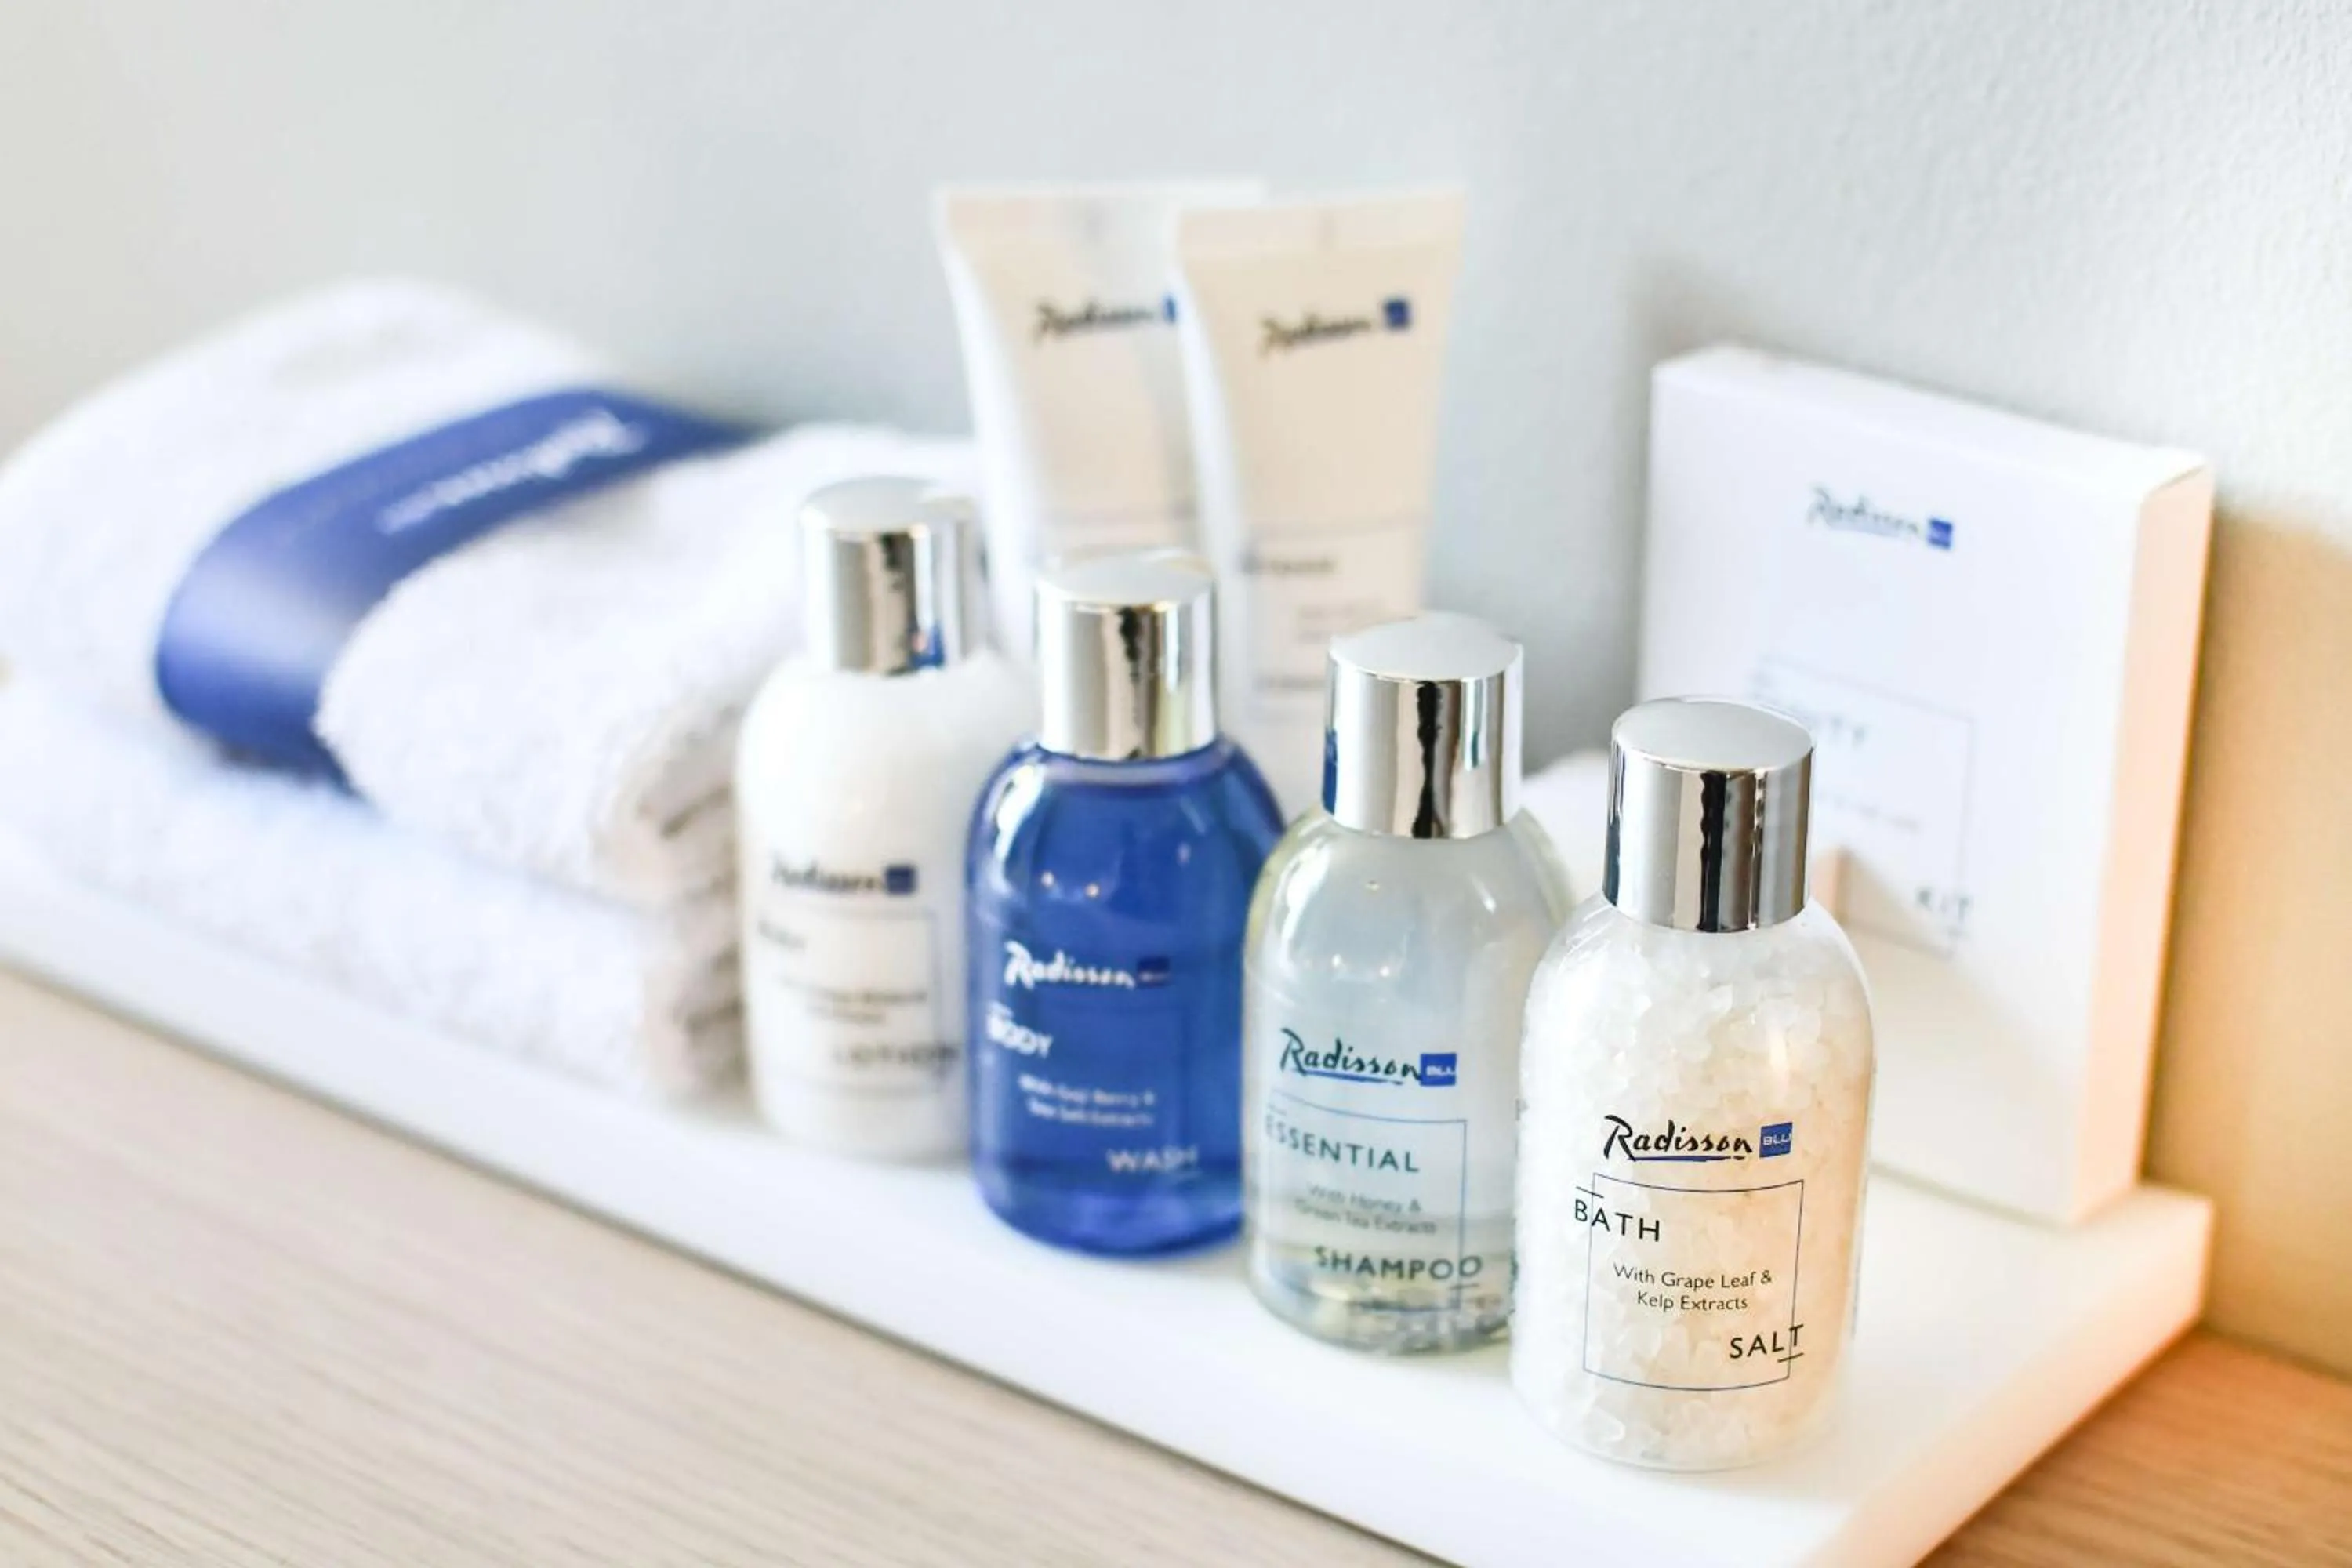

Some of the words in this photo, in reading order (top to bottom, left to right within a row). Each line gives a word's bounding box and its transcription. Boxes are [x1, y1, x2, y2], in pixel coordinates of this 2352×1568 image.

[1004, 940, 1136, 989] Radisson
[1279, 1027, 1423, 1084] Radisson
[1266, 1114, 1420, 1174] ESSENTIAL
[1603, 1115, 1753, 1161] Radisson
[1762, 1133, 1791, 1146] BLU
[1106, 1145, 1199, 1173] WASH
[1574, 1199, 1661, 1242] BATH
[1314, 1243, 1483, 1281] SHAMPOO
[1613, 1262, 1655, 1284] With
[1661, 1272, 1715, 1291] Grape
[1721, 1271, 1756, 1288] Leaf
[1761, 1269, 1772, 1285] &
[1637, 1291, 1674, 1312] Kelp
[1680, 1296, 1748, 1311] Extracts
[1729, 1324, 1805, 1359] SALT
